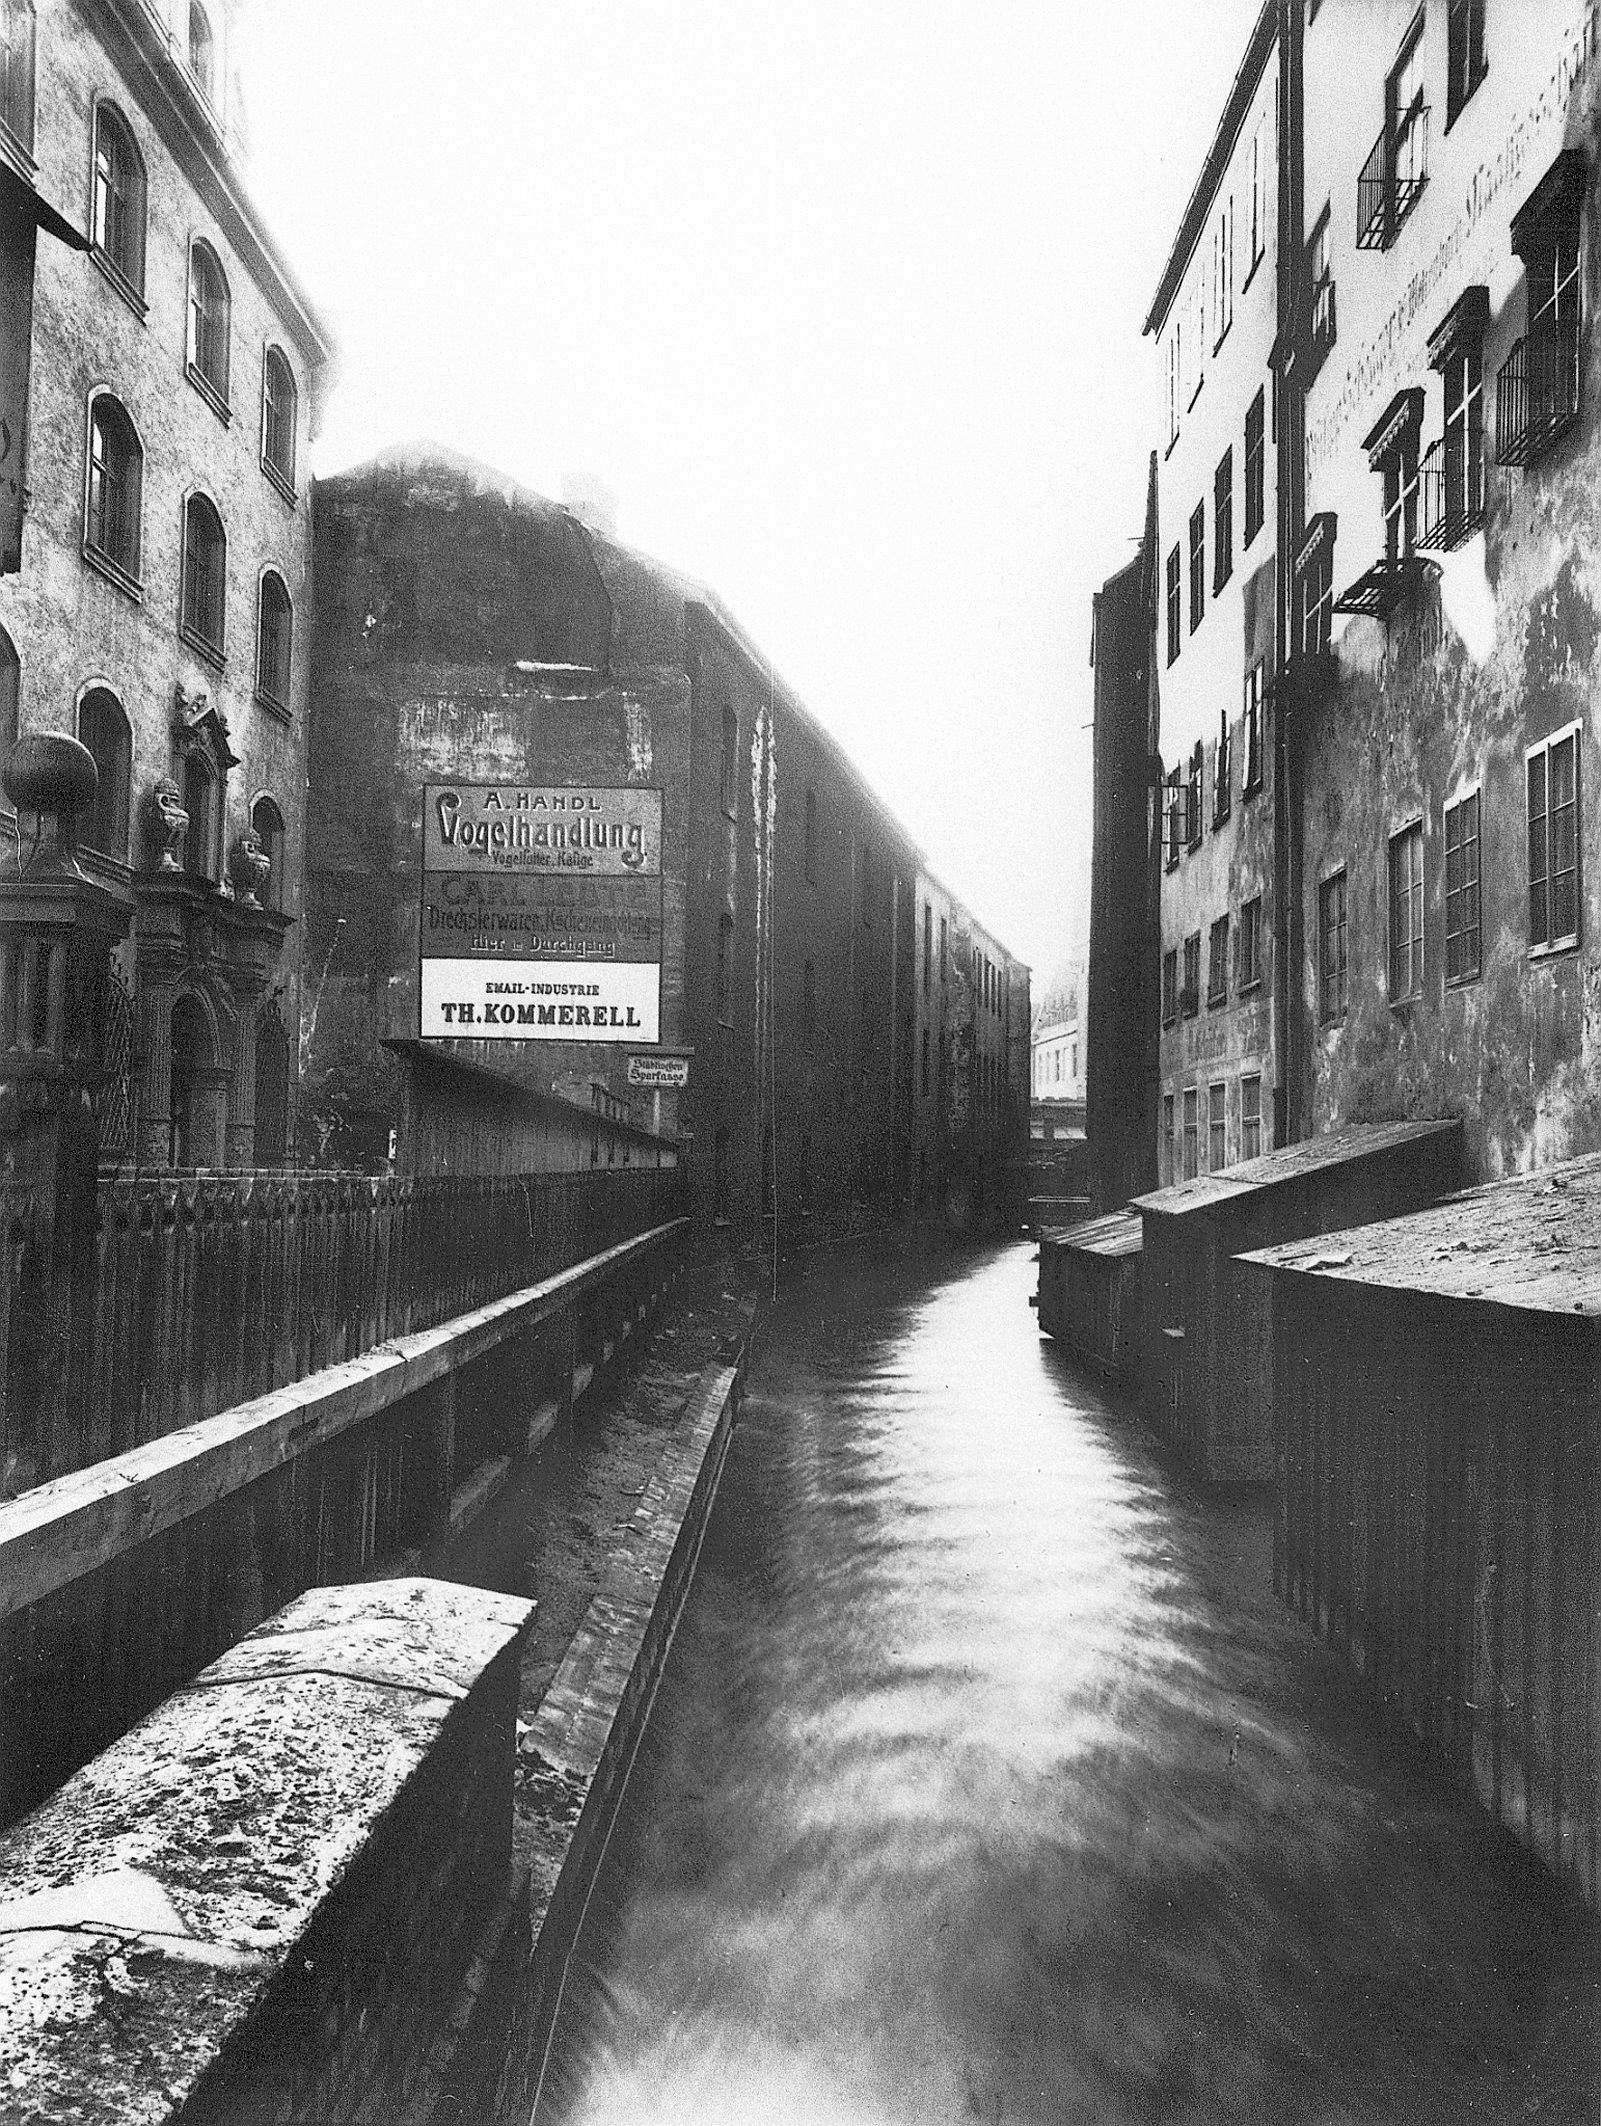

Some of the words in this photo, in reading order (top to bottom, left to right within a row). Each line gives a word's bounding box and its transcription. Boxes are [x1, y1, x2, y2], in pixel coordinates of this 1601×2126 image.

[483, 791, 511, 811] A.
[516, 792, 602, 812] HANDL
[436, 792, 646, 871] Vogelhandlung
[485, 982, 600, 996] EMAIL-INDUSTRIE
